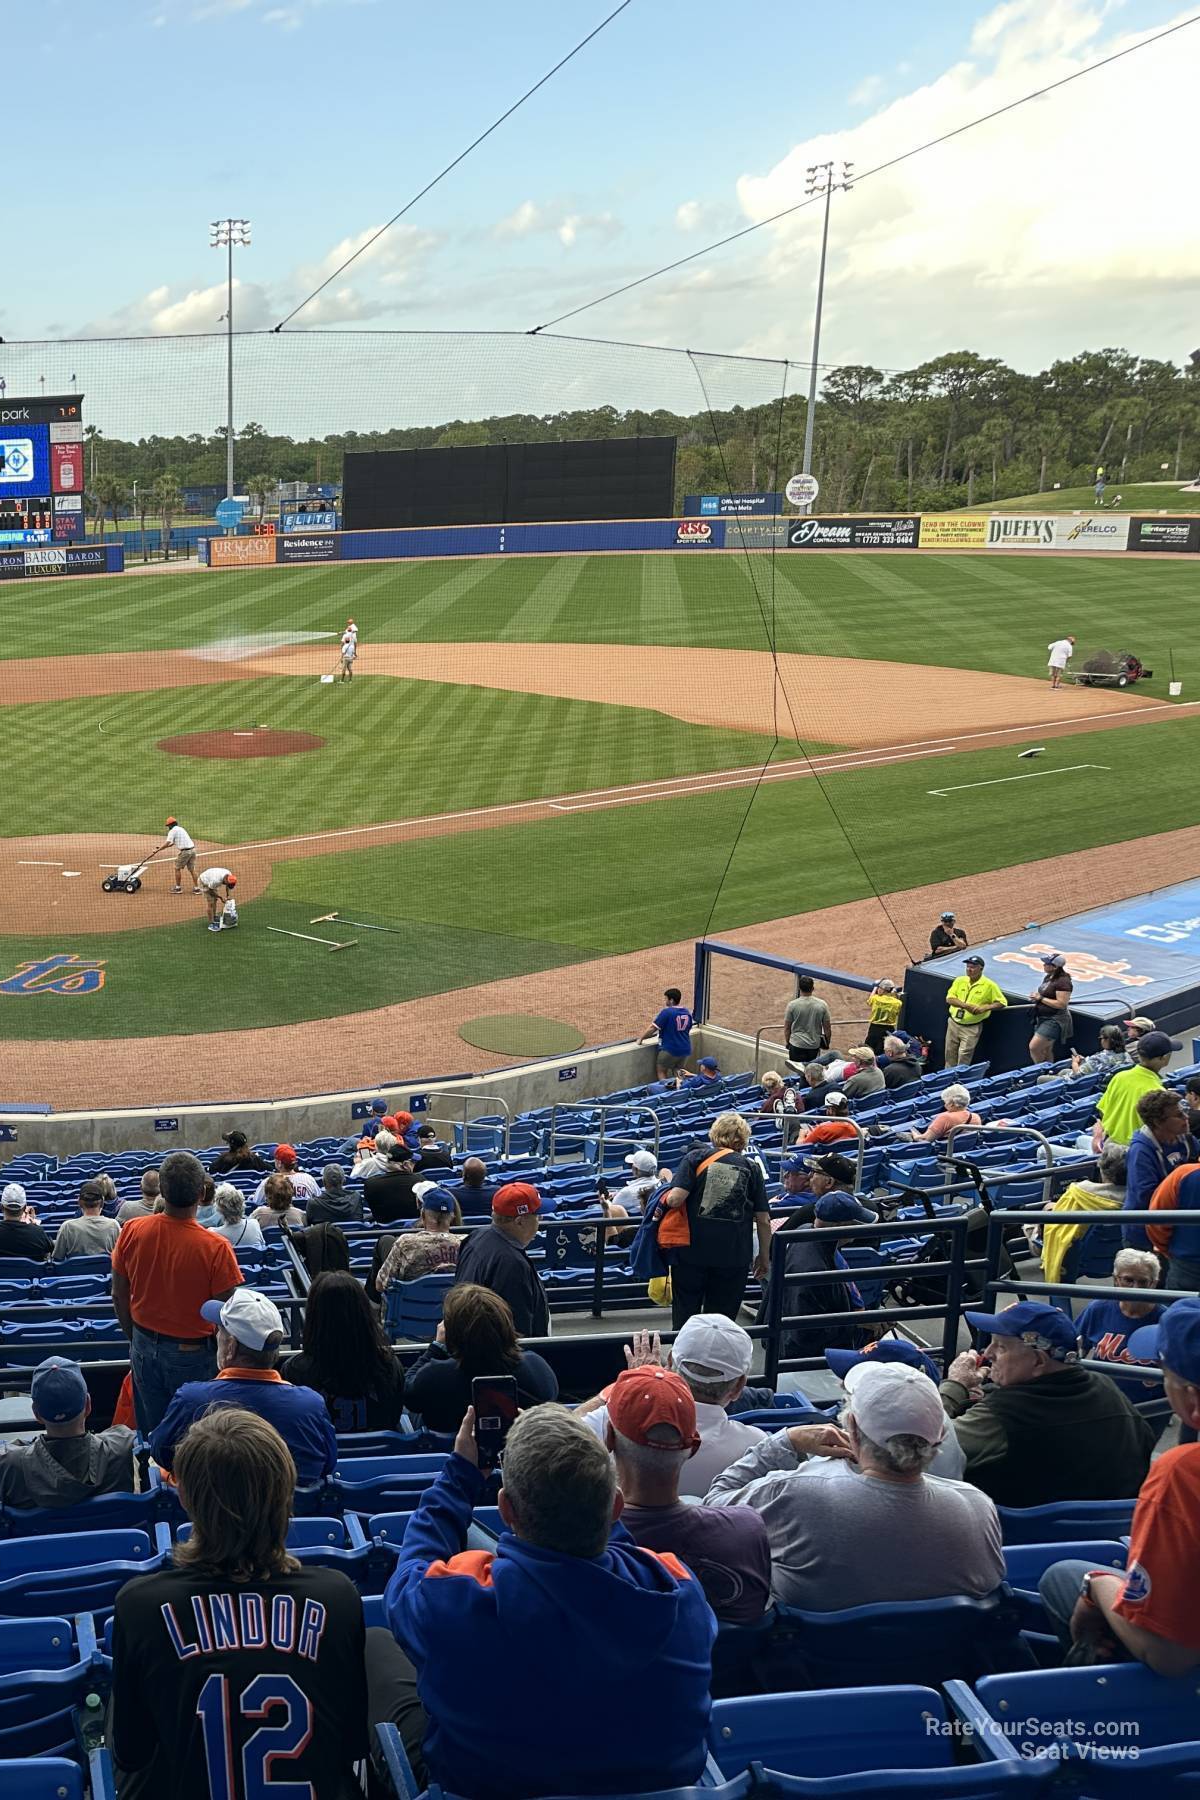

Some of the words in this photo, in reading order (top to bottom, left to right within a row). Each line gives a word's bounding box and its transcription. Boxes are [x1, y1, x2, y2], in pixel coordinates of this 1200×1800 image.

[16, 503, 22, 512] 0
[286, 514, 332, 525] ELITE
[680, 522, 710, 535] RSG
[727, 526, 784, 534] COURTYARD
[791, 520, 851, 544] Dream
[1074, 525, 1117, 533] GERELCO
[284, 539, 324, 548] Residence
[862, 536, 880, 544] (772)
[24, 550, 65, 564] BARON
[68, 552, 101, 561] BARON
[29, 565, 62, 574] LUXURY
[675, 1015, 689, 1031] 17
[557, 1248, 566, 1259] 9
[160, 1592, 326, 1663] LINDOR
[196, 1673, 317, 1800] 12
